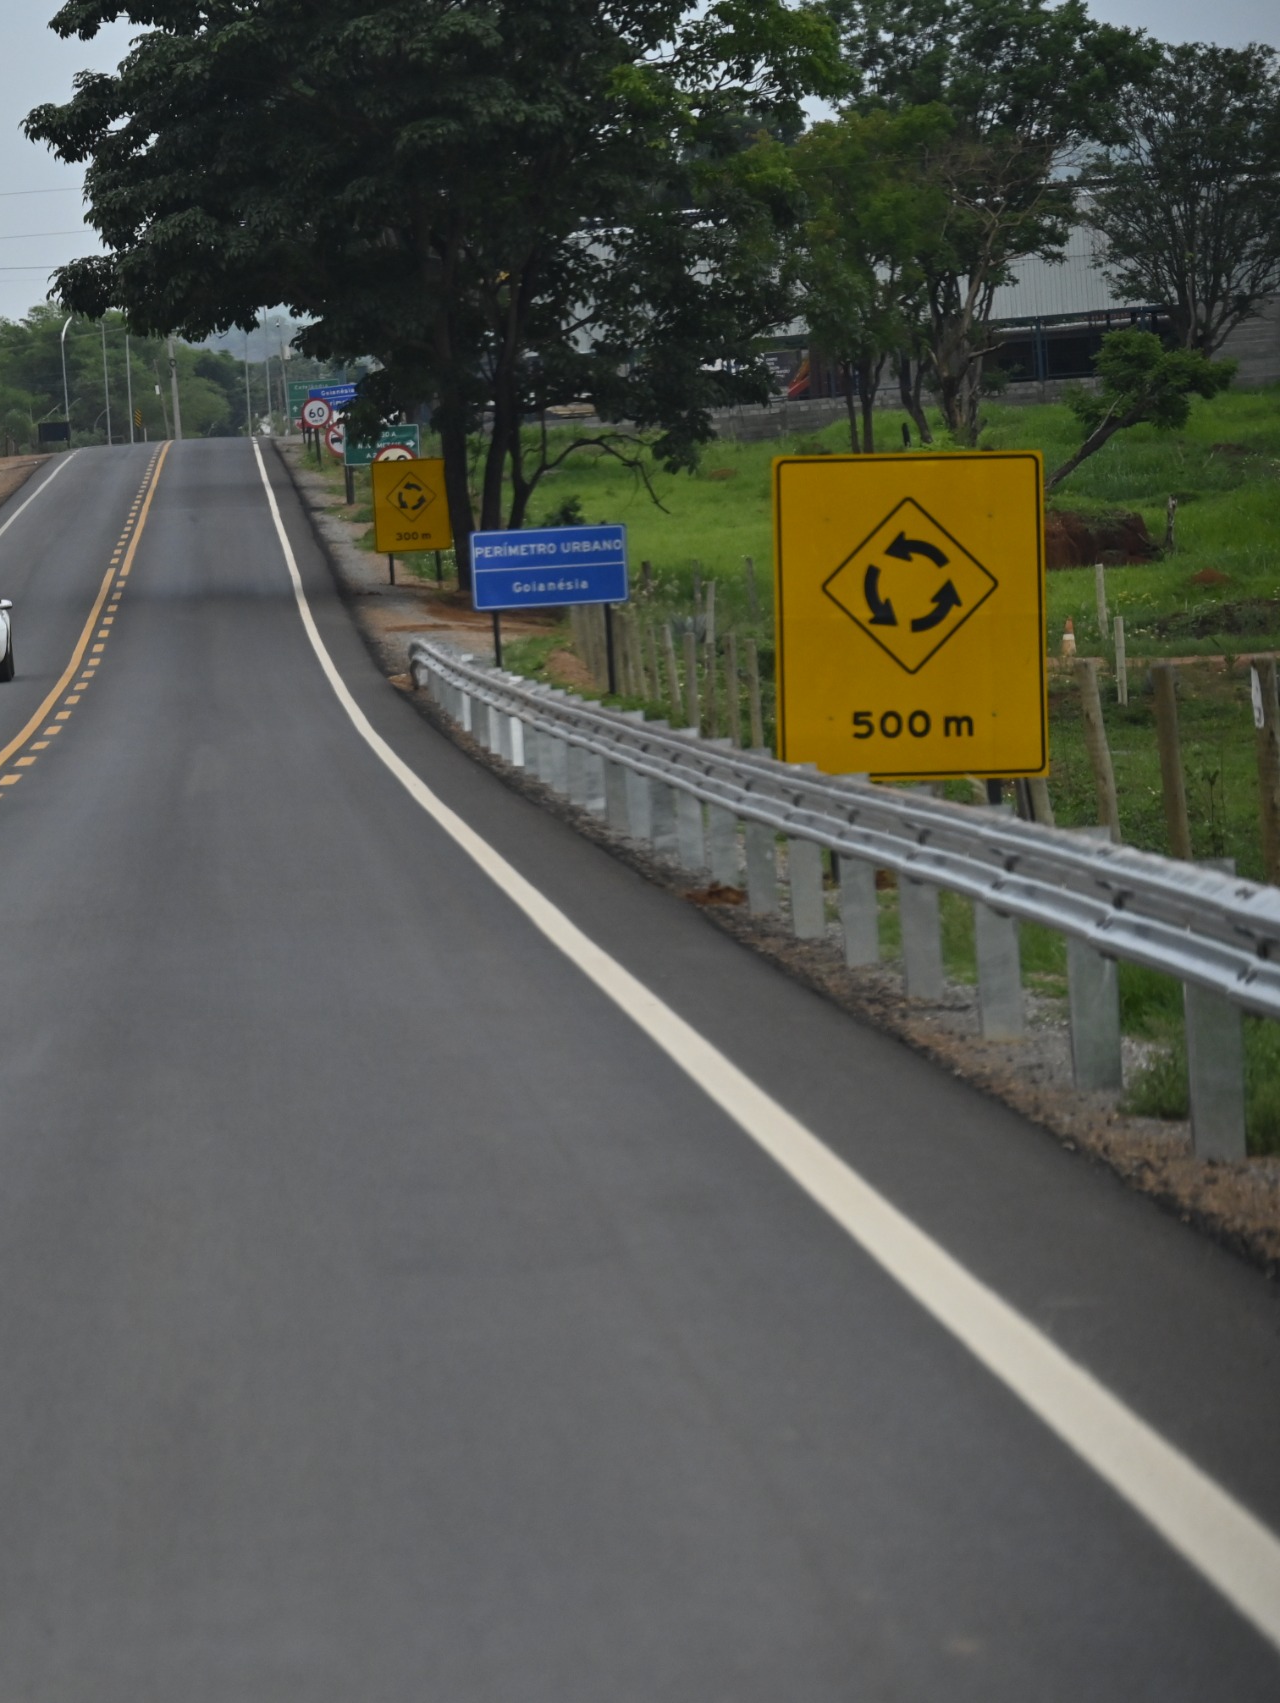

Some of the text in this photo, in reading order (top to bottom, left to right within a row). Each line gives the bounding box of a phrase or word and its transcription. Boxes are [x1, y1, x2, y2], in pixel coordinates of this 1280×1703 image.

[320, 387, 355, 396] Goianésia
[309, 407, 325, 418] 60
[396, 531, 432, 541] 300 m
[475, 539, 623, 558] PERÍMETRO URBANO
[512, 578, 589, 593] Goianésia
[852, 709, 974, 739] 500 m
